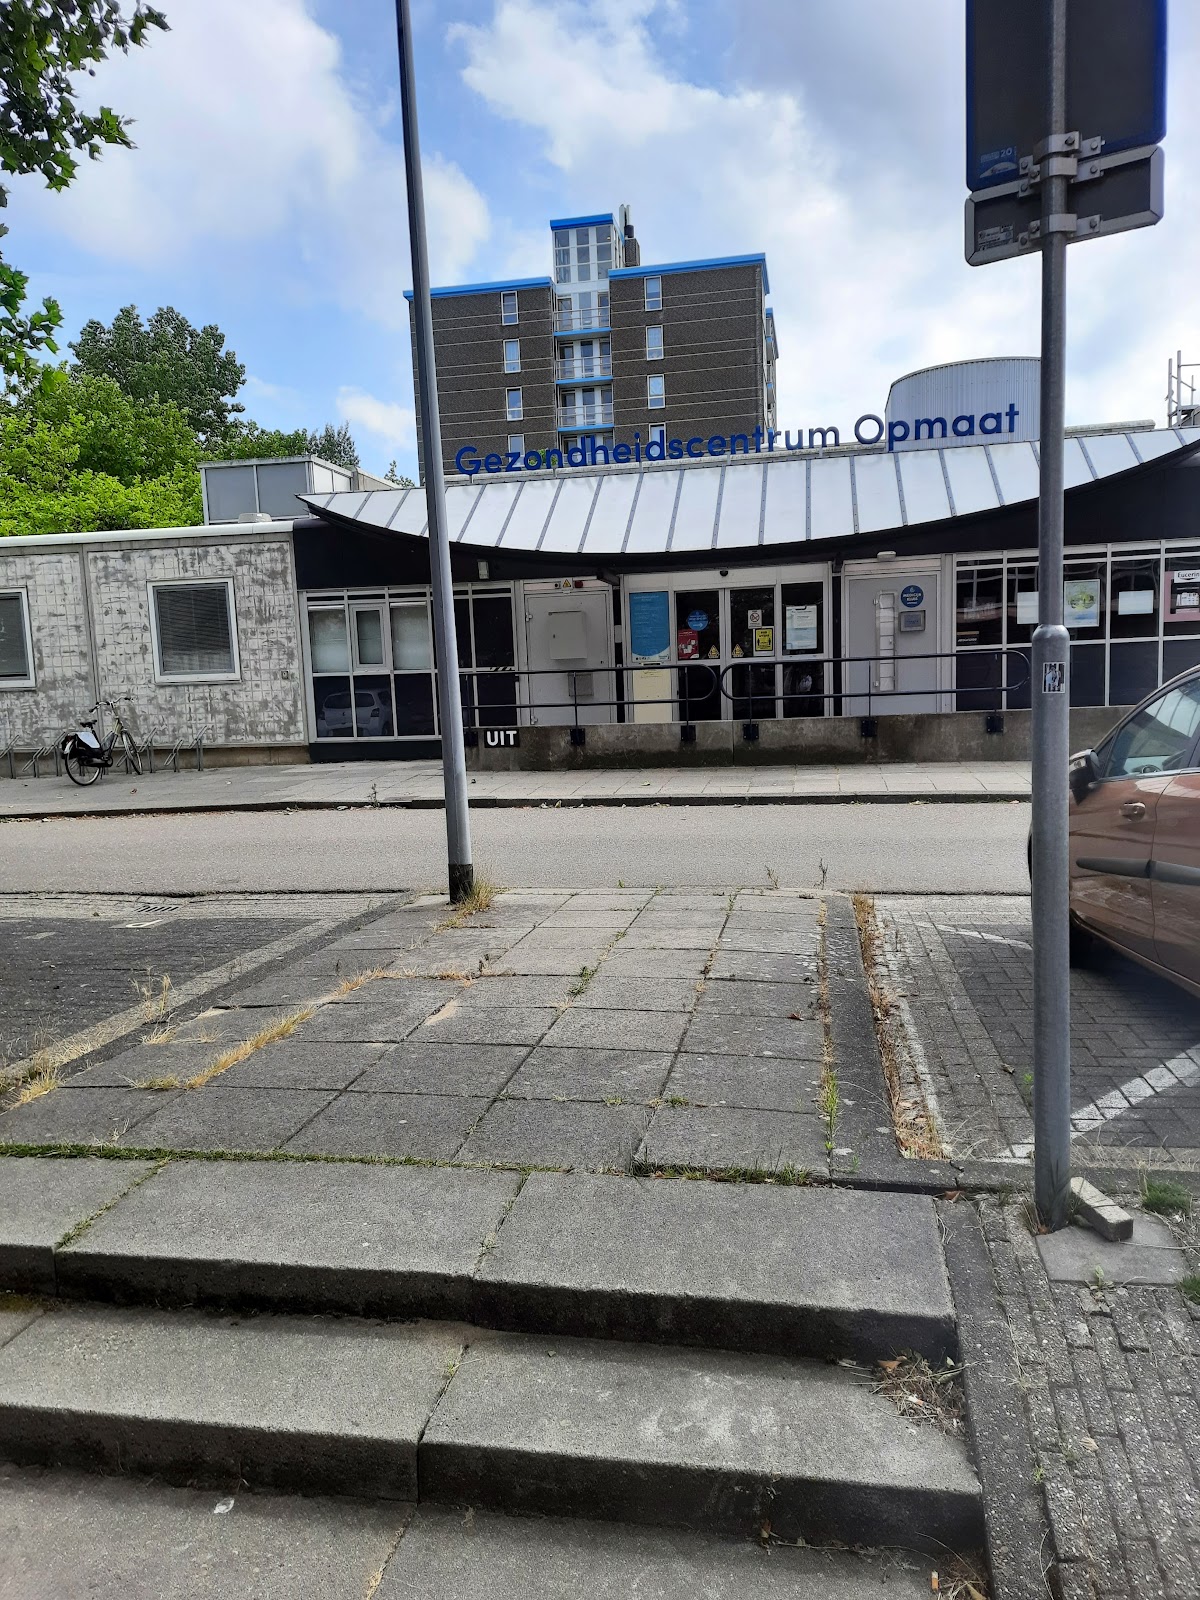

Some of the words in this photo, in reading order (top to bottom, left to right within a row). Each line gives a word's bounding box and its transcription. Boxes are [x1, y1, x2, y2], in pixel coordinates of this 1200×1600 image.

[455, 425, 840, 476] Gezondheidscentrum
[854, 402, 1020, 452] Opmaat
[486, 730, 518, 746] UIT
